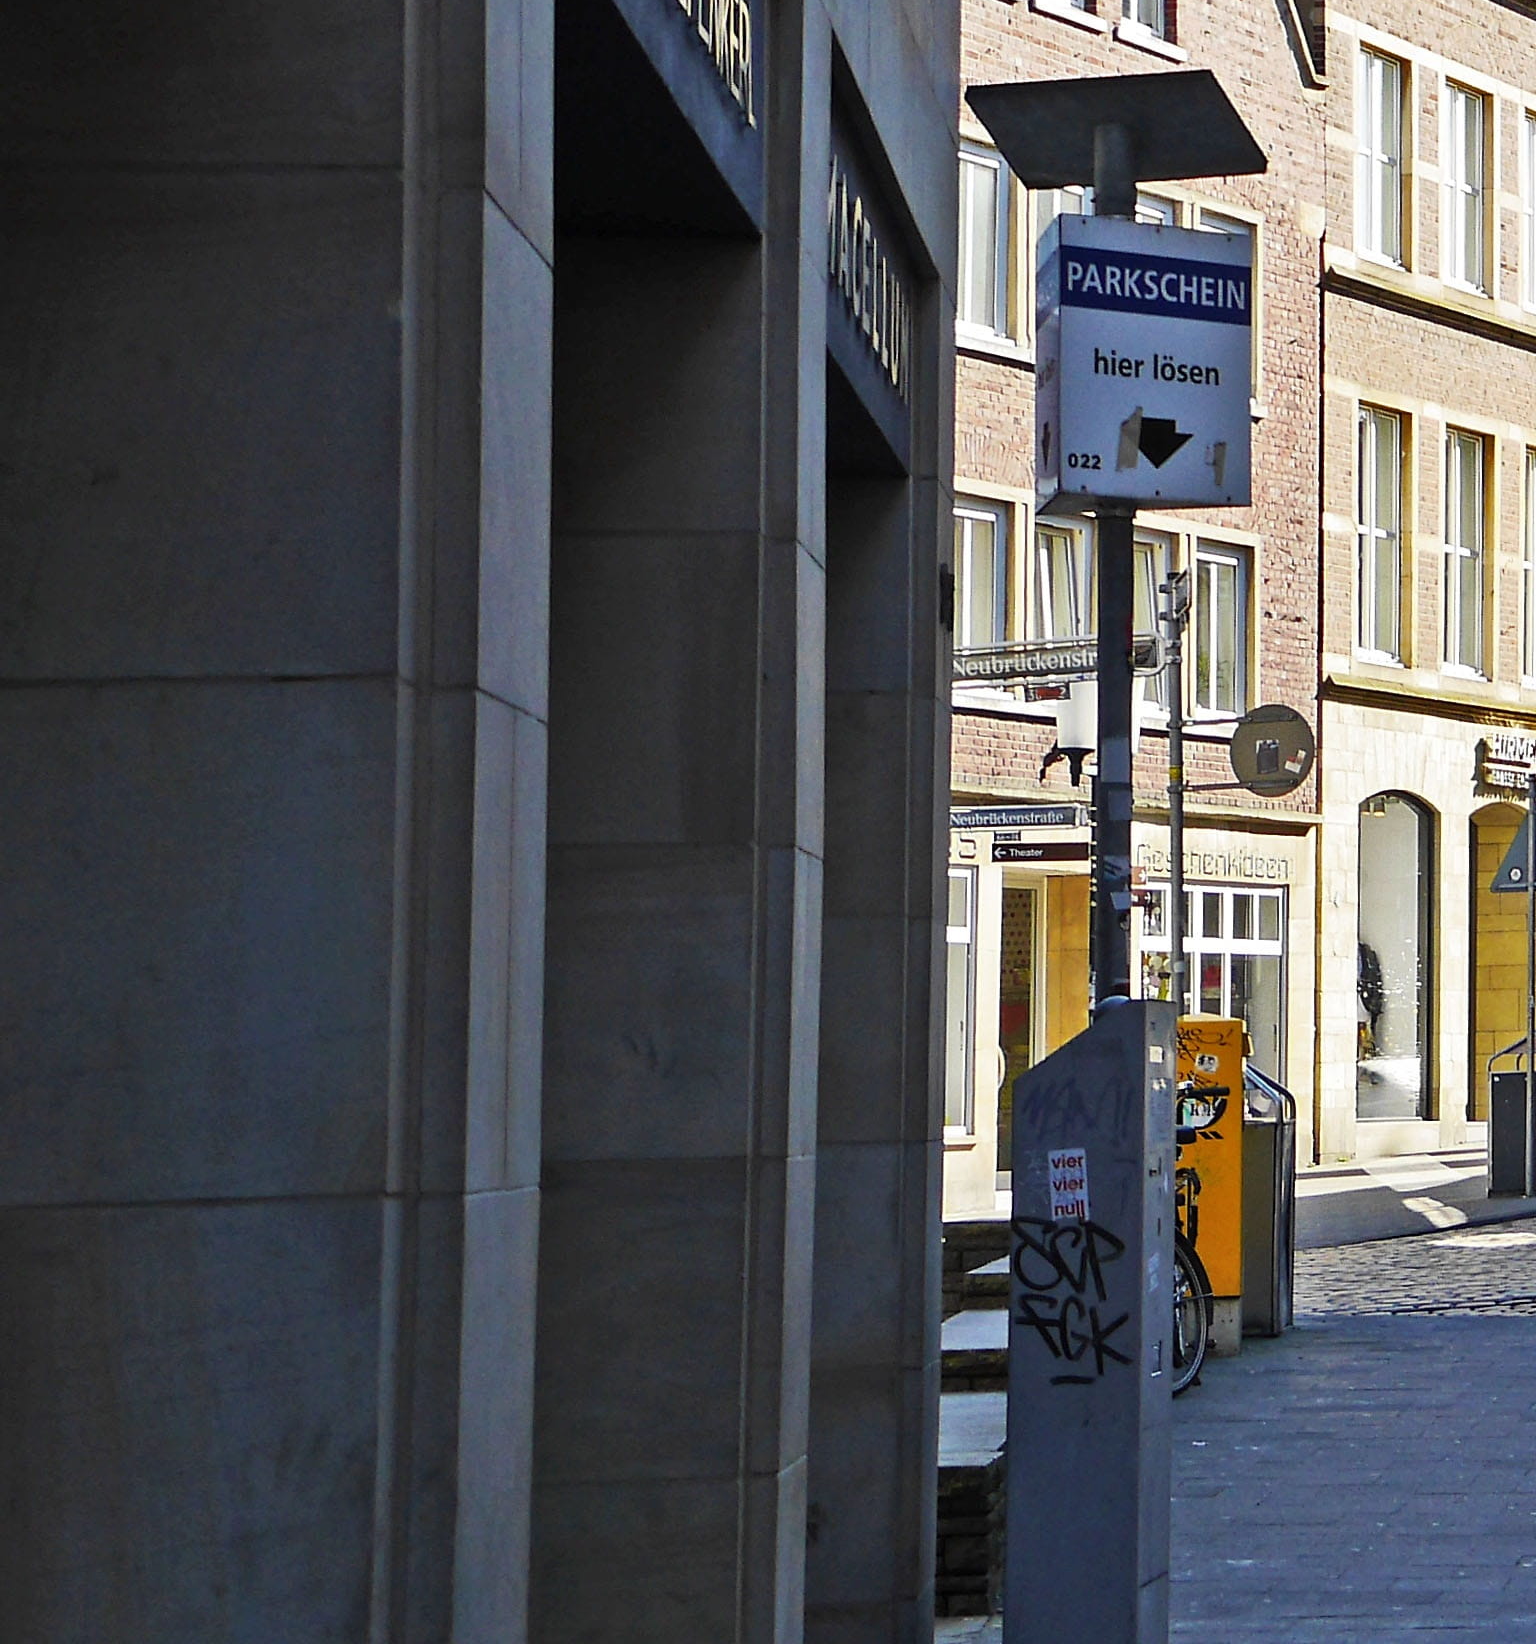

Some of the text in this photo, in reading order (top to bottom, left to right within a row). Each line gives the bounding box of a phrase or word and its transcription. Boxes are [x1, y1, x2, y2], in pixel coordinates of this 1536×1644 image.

[1066, 260, 1247, 311] PARKSCHEIN
[1093, 347, 1144, 378] hier
[1153, 353, 1220, 386] lösen
[1067, 452, 1102, 470] 022
[950, 809, 1065, 828] Neubrückenstraße
[1009, 847, 1044, 858] Theater
[1050, 1154, 1085, 1170] vier
[1052, 1177, 1085, 1193] vier
[1054, 1198, 1086, 1218] null
